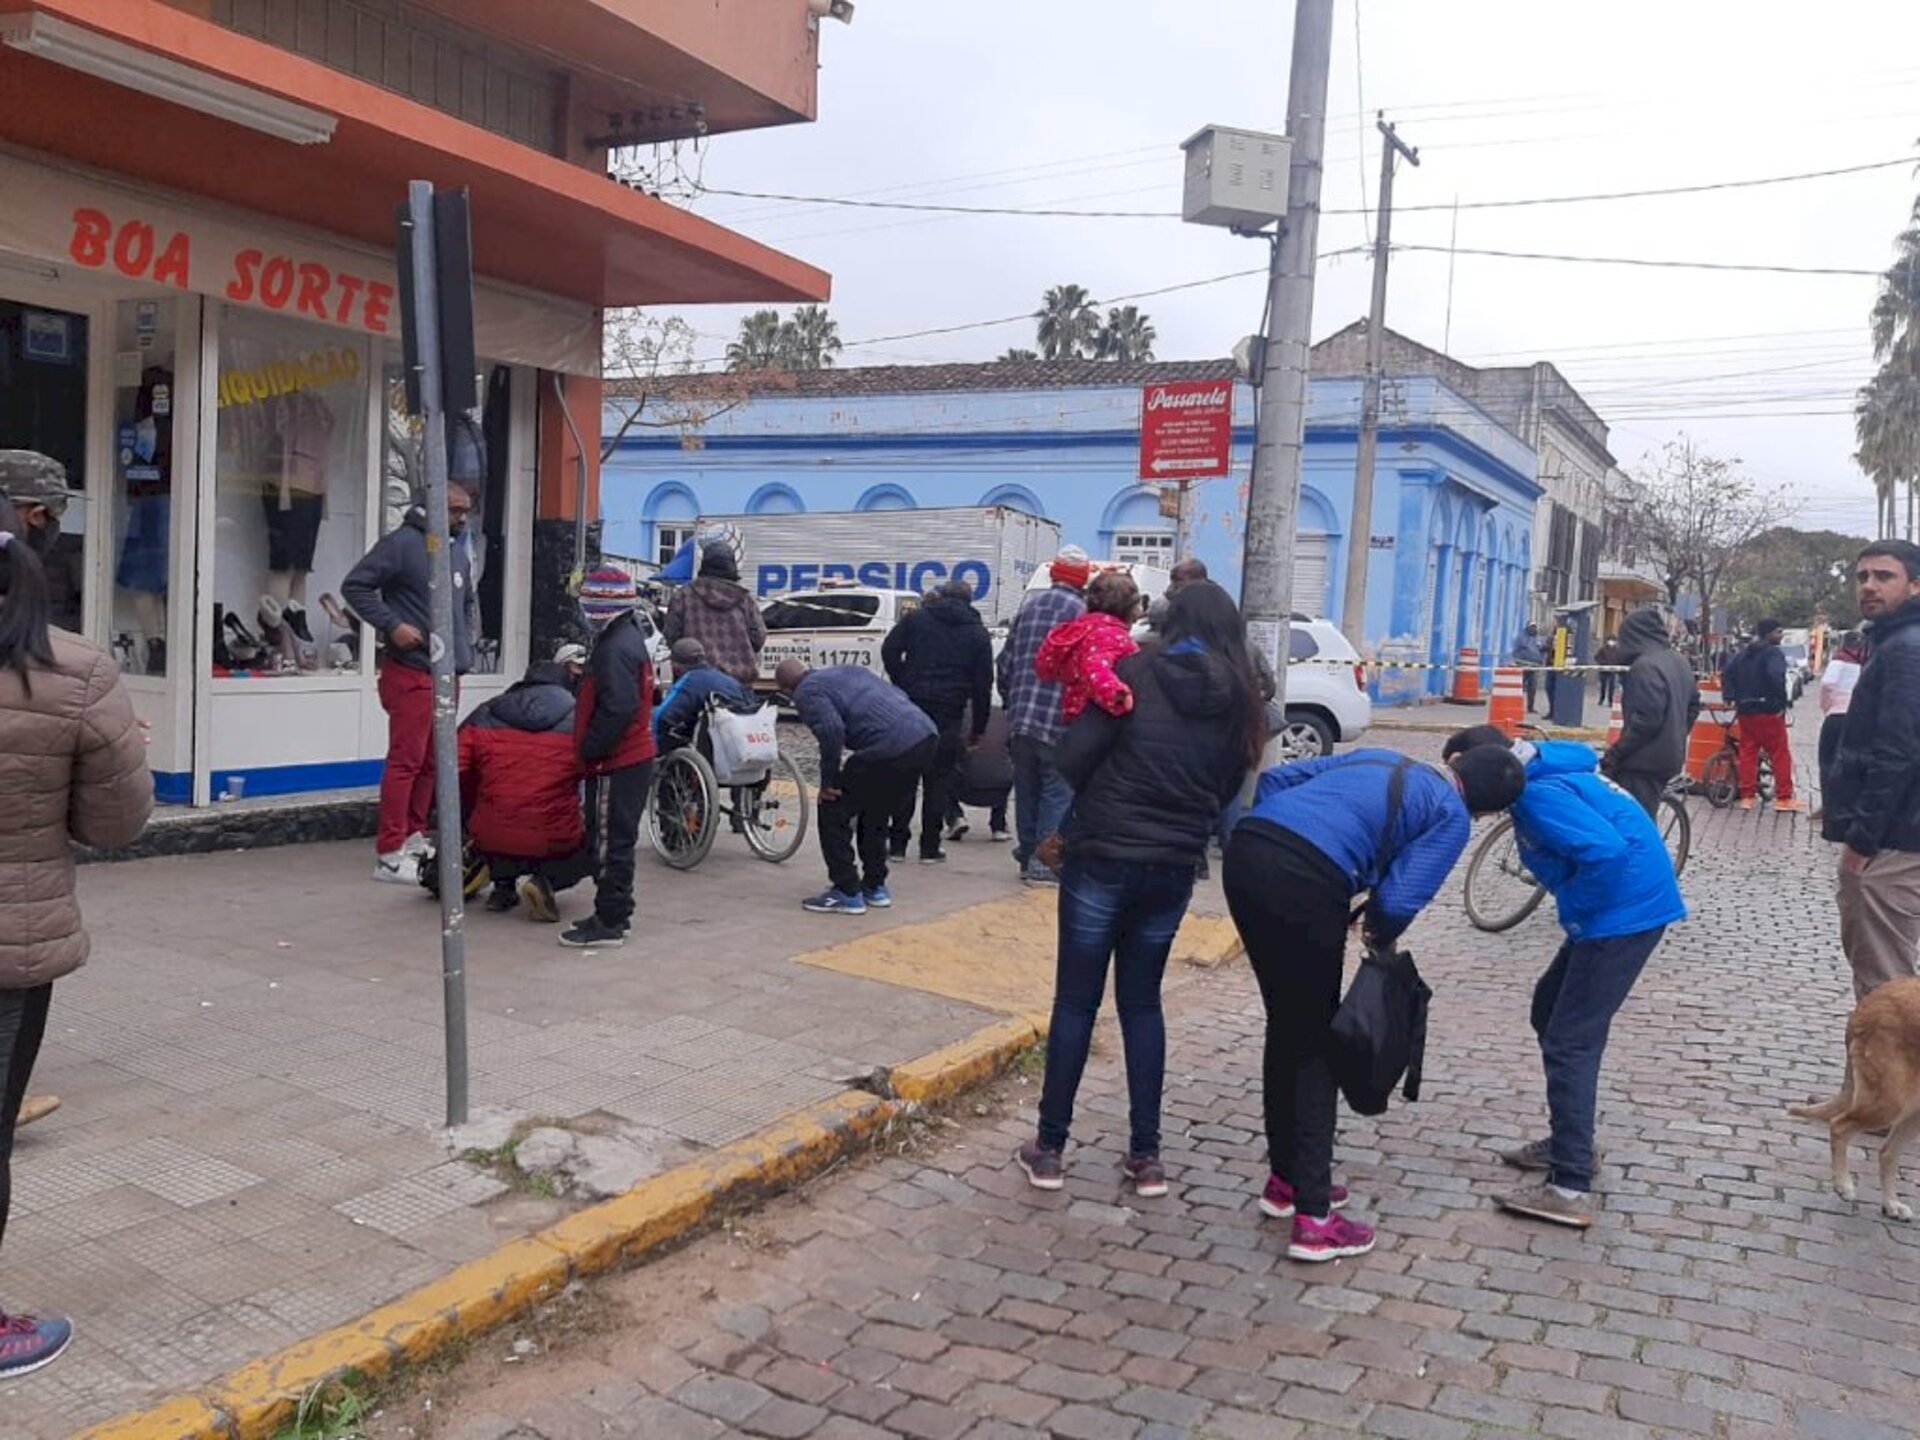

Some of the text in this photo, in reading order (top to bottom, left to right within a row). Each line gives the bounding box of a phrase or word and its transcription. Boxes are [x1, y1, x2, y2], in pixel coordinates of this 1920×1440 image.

[70, 207, 190, 289] BOA
[226, 249, 395, 332] SORTE
[819, 650, 871, 666] 11773
